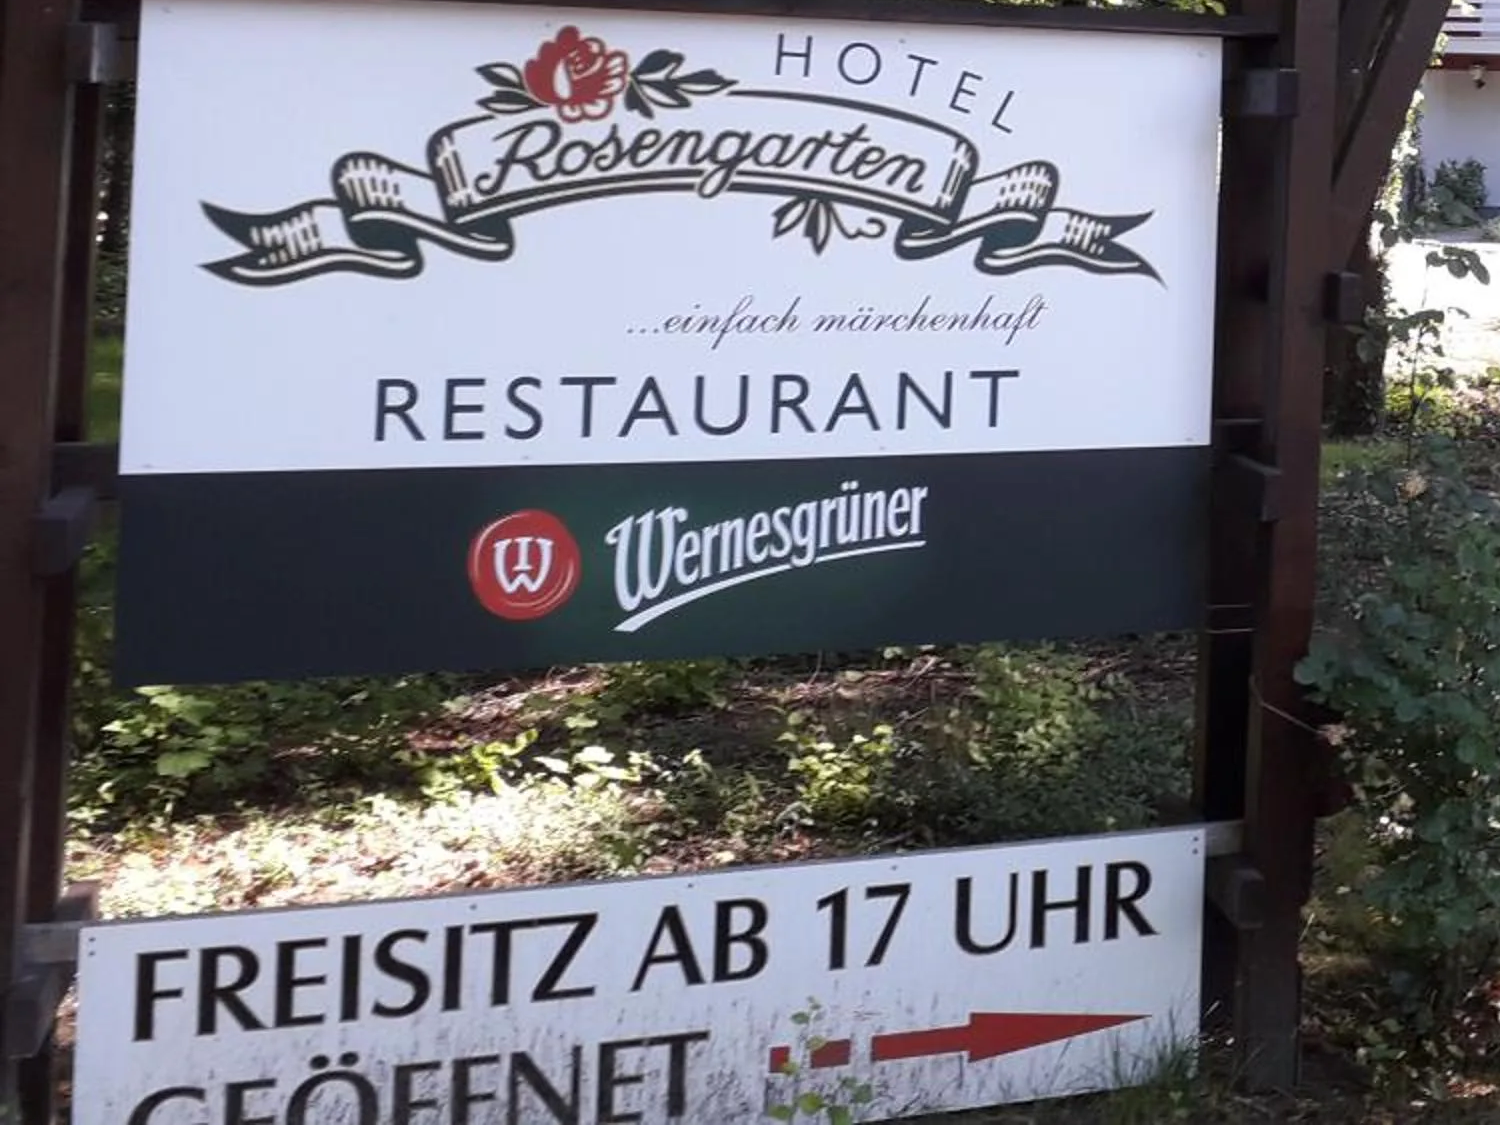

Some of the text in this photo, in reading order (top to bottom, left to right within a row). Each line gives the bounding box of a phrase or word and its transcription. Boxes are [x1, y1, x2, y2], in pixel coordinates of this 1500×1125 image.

[774, 32, 1017, 134] HOTEL
[476, 121, 926, 198] Rosengarten
[626, 293, 1050, 350] ...einfach märchenhaft
[373, 369, 1021, 443] RESTAURANT
[604, 480, 929, 612] Wernesgrüner
[131, 860, 1160, 1042] FREISITZ AB 17 UHR
